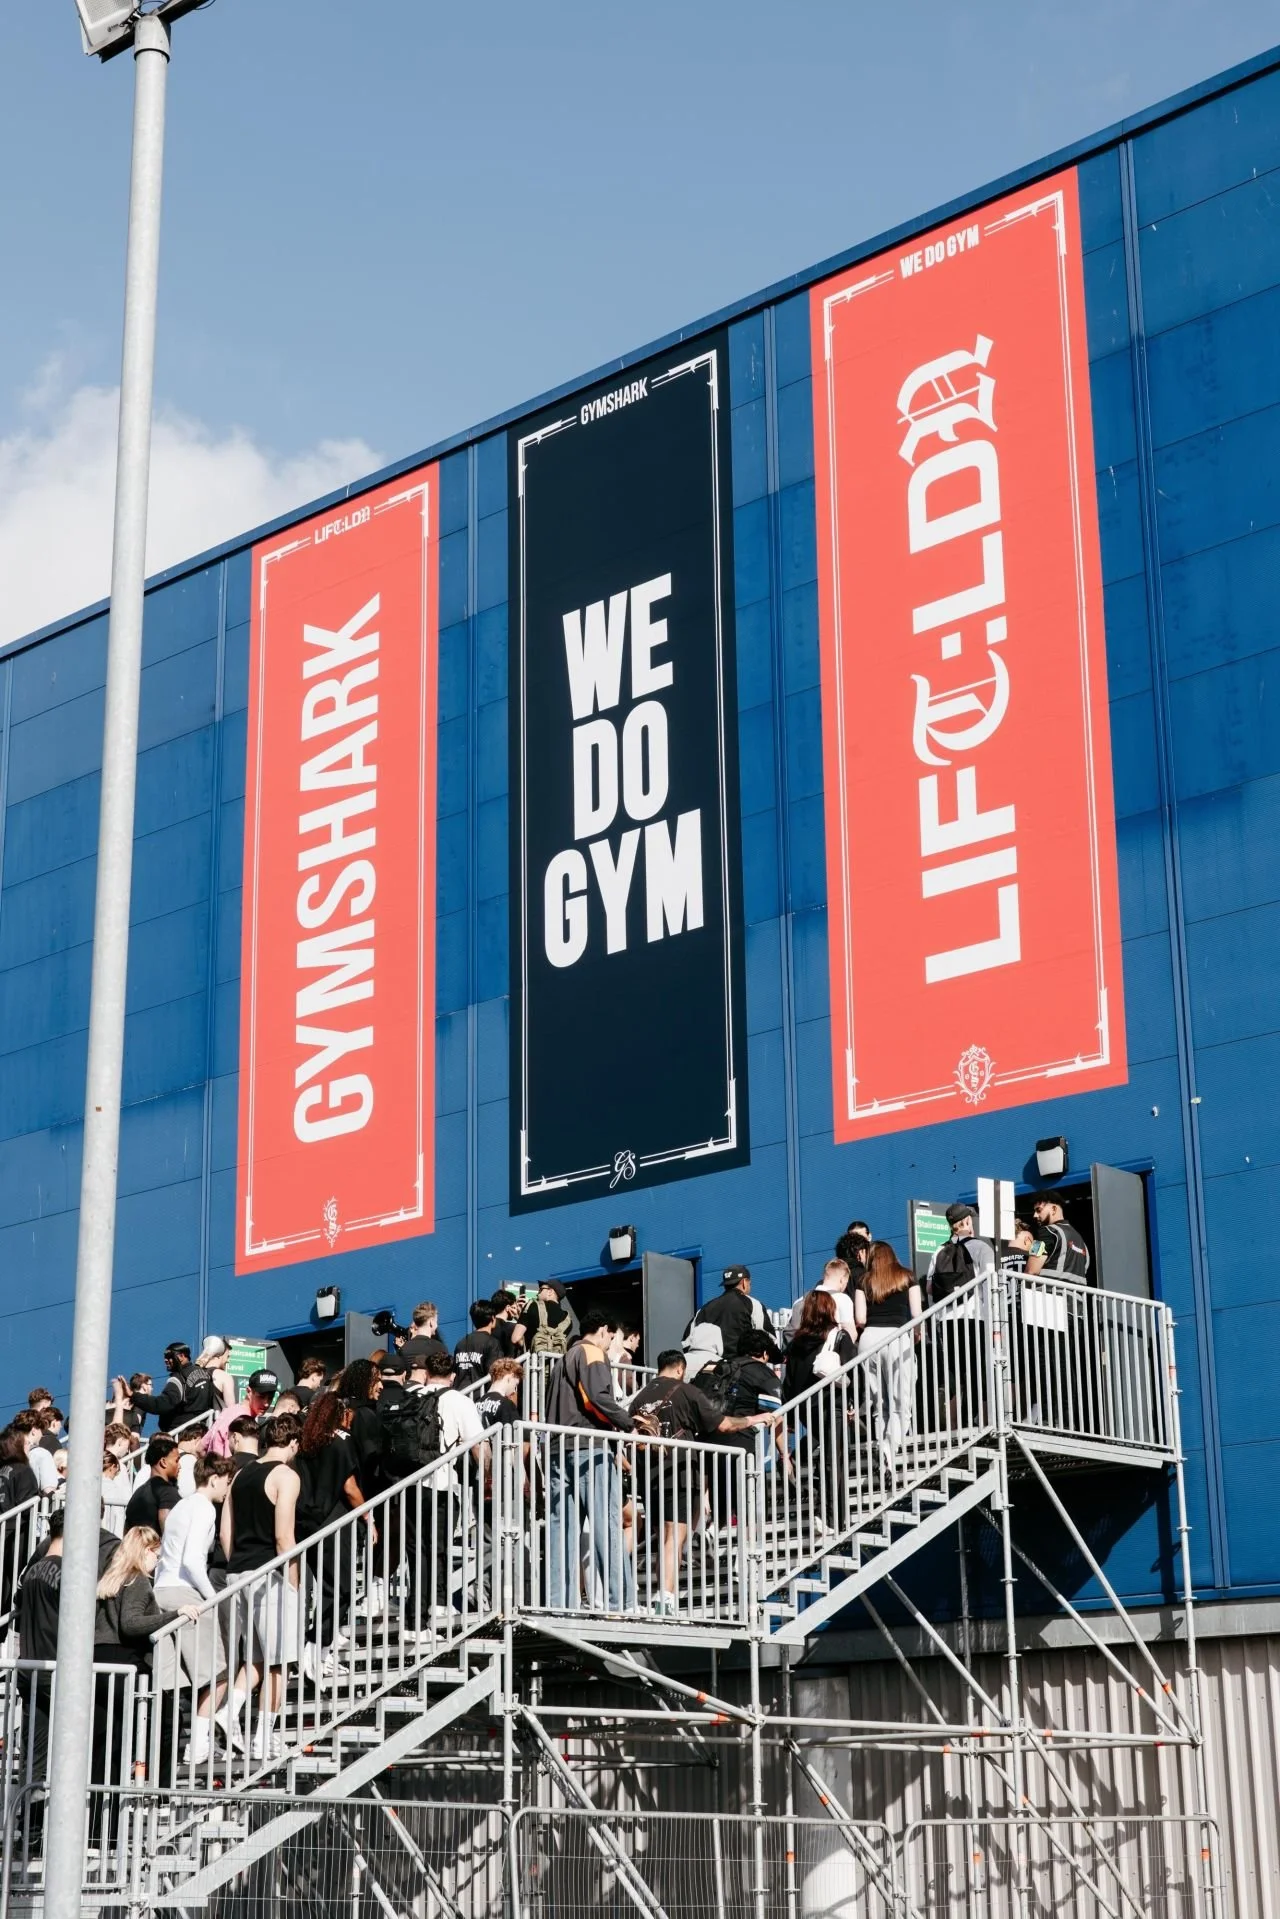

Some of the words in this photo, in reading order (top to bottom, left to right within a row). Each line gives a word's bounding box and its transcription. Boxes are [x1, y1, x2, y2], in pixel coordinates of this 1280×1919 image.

[900, 250, 923, 279] WE
[924, 241, 945, 269] DO
[946, 224, 980, 257] GYM
[580, 377, 648, 425] GYMSHARK
[562, 572, 674, 721] WE
[572, 700, 670, 841] DO
[293, 592, 381, 1144] GYMSHARK
[544, 808, 705, 968] GYM
[917, 1237, 936, 1247] Level
